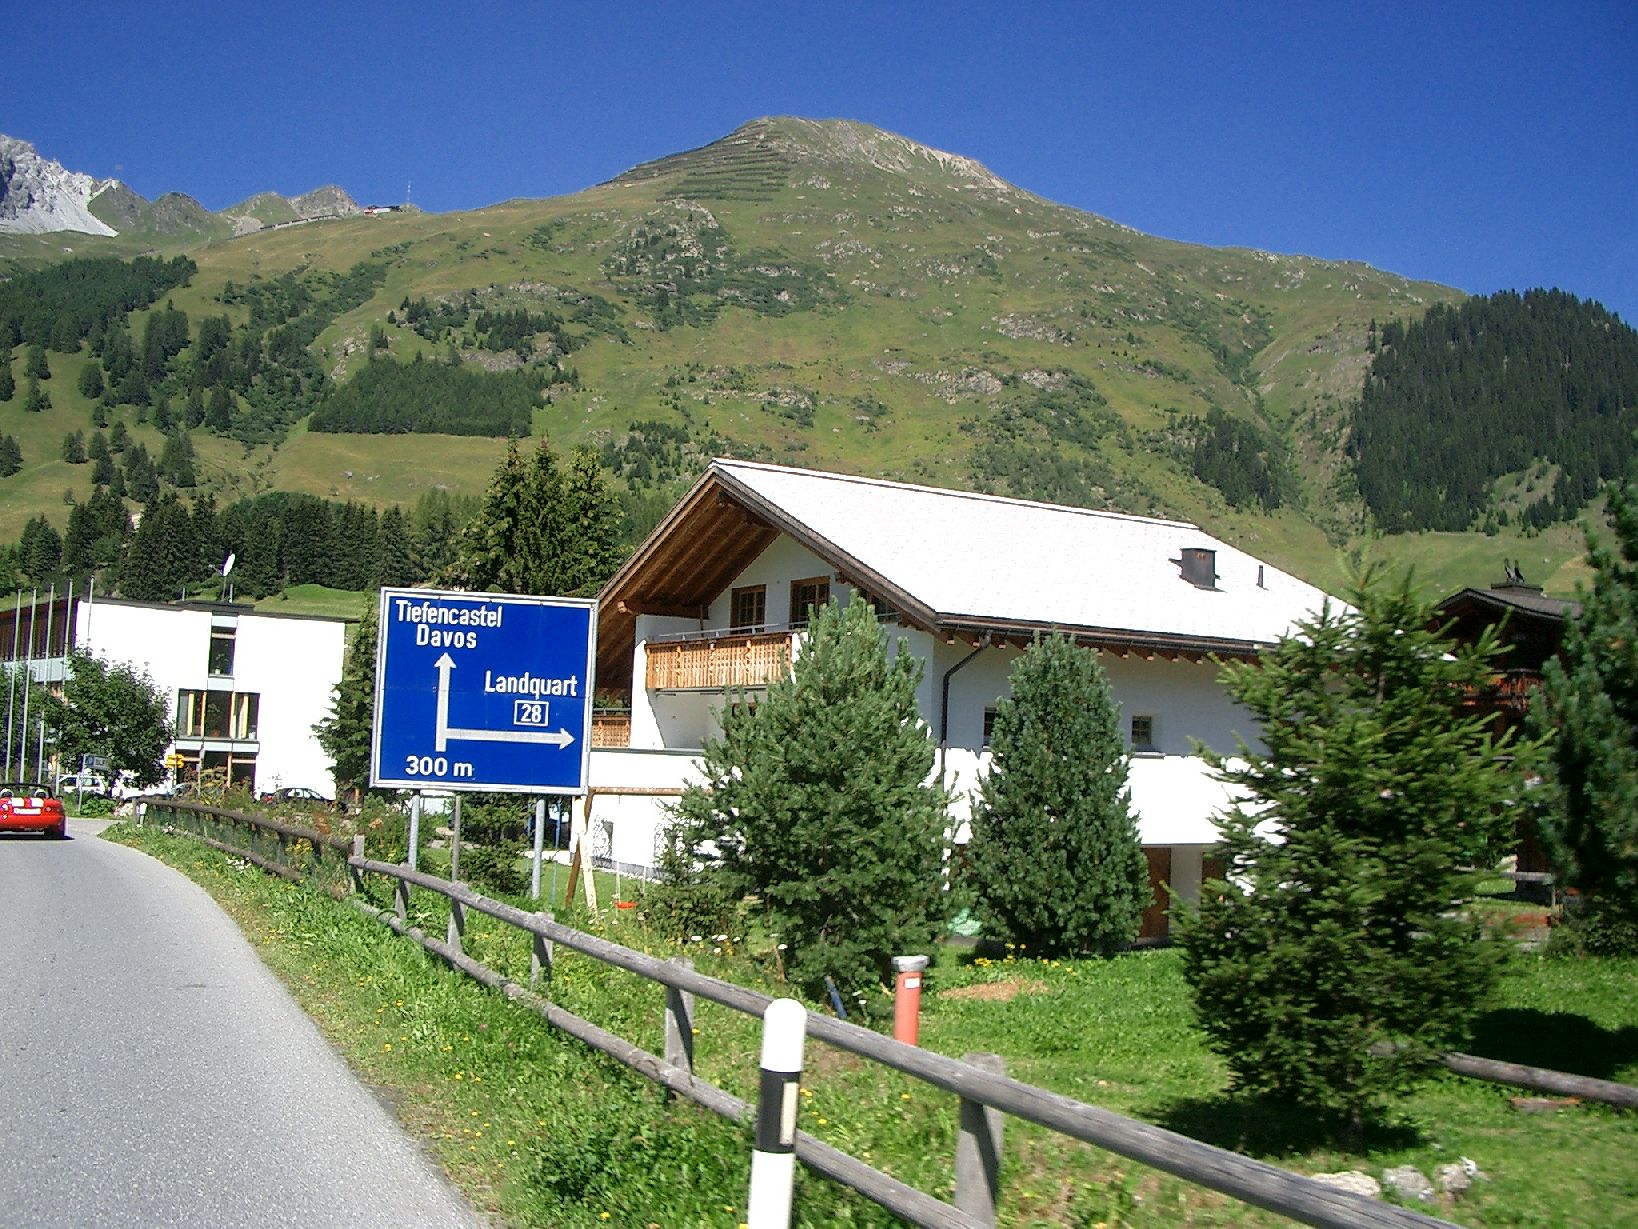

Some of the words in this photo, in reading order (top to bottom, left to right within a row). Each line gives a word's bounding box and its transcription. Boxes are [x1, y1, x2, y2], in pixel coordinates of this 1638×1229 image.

[396, 599, 503, 628] Tiefencastel
[416, 624, 477, 649] Davos
[484, 670, 578, 699] Landquart
[520, 704, 542, 723] 28
[405, 755, 448, 777] 300
[453, 762, 473, 777] m
